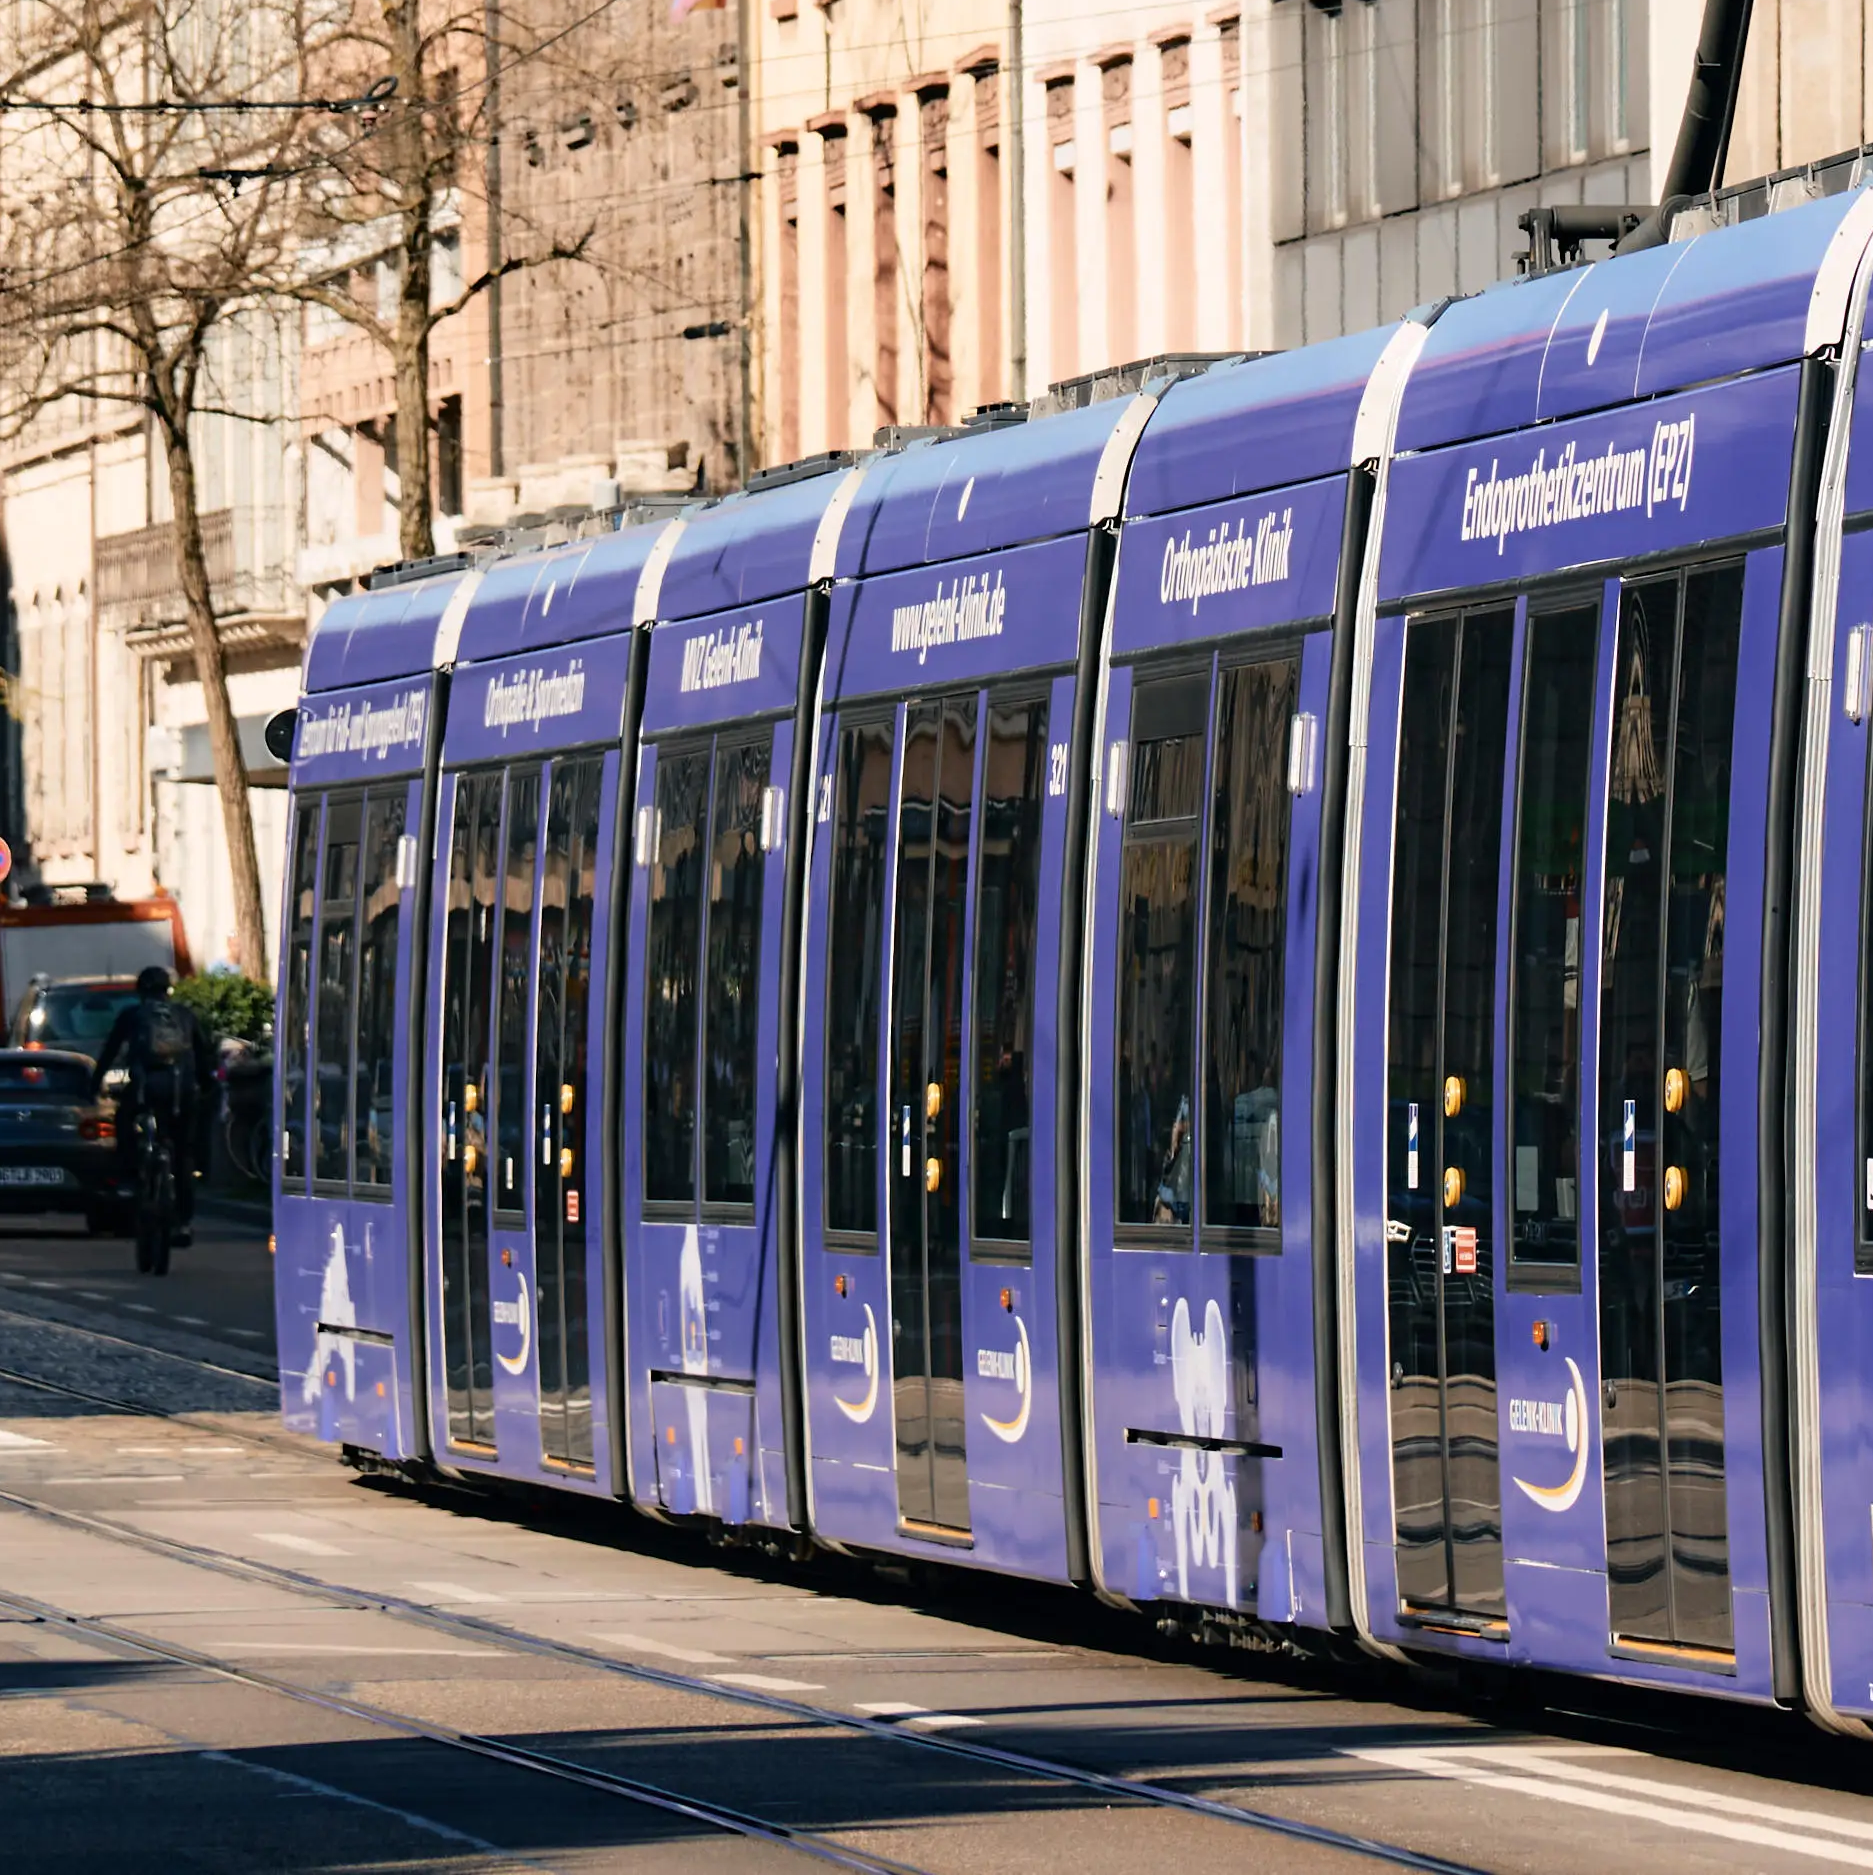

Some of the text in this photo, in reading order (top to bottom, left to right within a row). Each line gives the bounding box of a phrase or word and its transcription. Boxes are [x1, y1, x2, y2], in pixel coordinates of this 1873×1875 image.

[1460, 412, 1695, 556] Endoprothetikzentrum (EPZ)
[1160, 507, 1293, 616] Orthopädische Klinik
[703, 619, 764, 689] Gelenk-Klinik
[891, 569, 1006, 665] www.gelenk-klinik.de
[1509, 1398, 1563, 1436] GELENK-KLINIK
